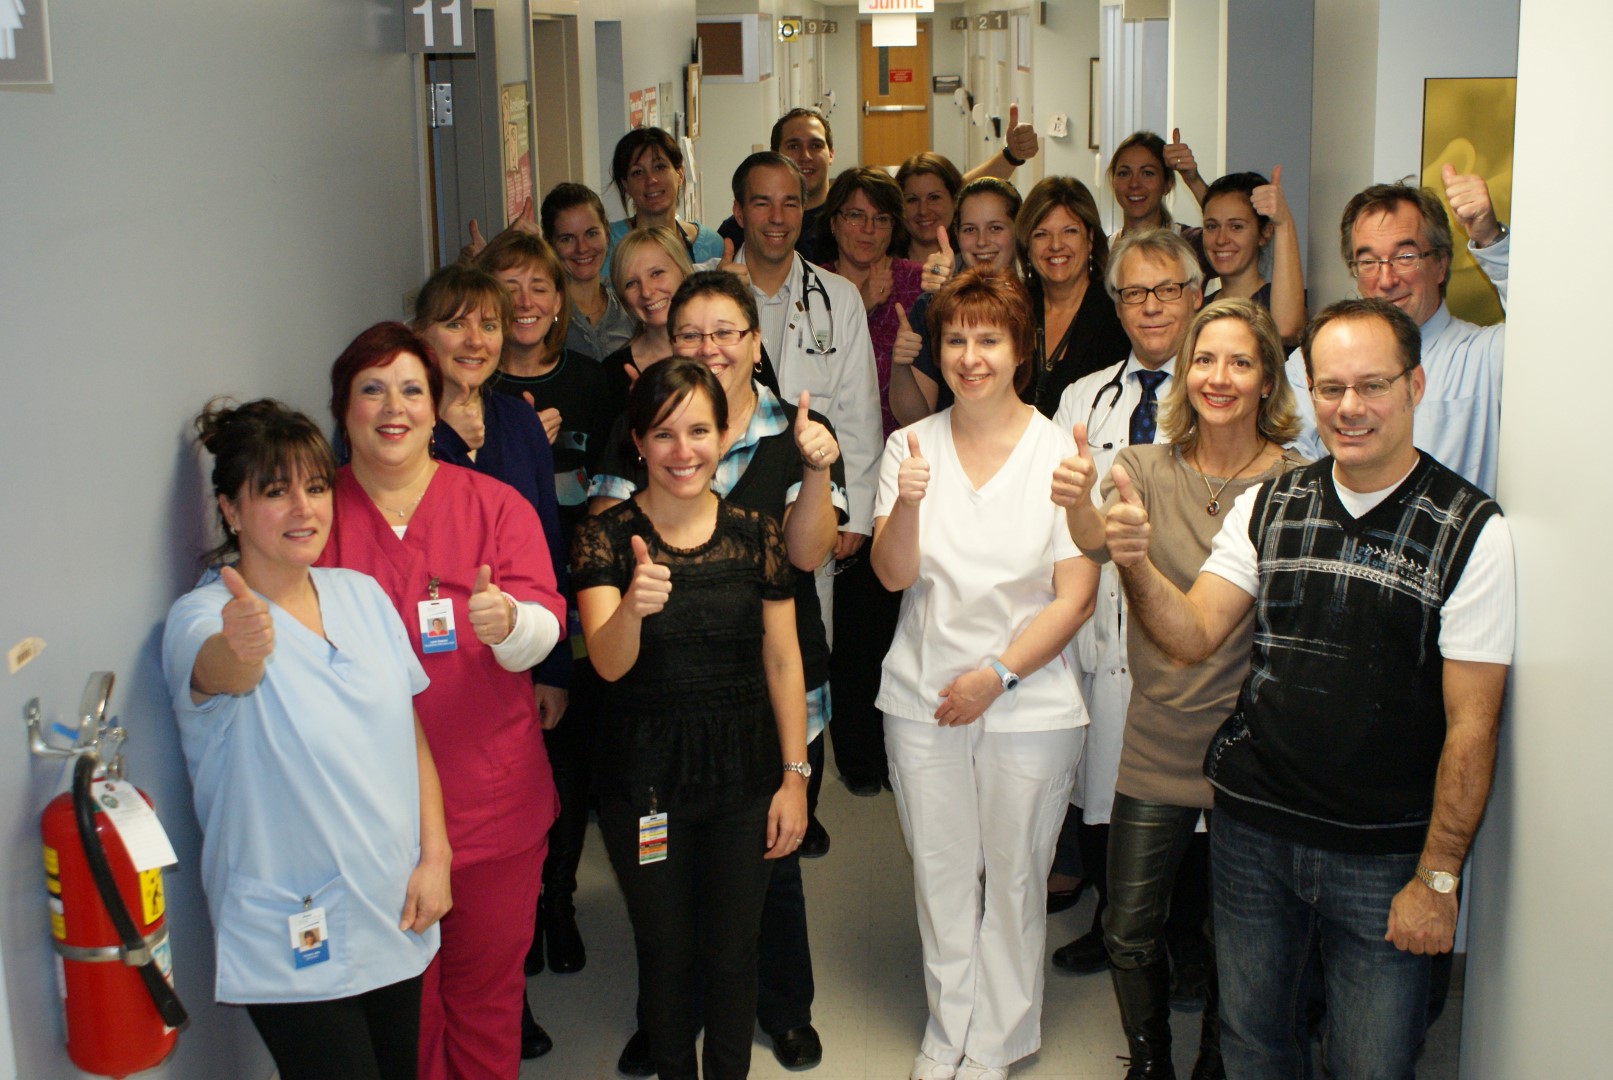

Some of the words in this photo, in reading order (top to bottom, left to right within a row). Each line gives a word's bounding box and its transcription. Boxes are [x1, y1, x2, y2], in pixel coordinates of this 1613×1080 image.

[413, 0, 462, 47] 11
[808, 21, 817, 34] 9
[979, 16, 988, 29] 2
[994, 14, 1002, 29] 1
